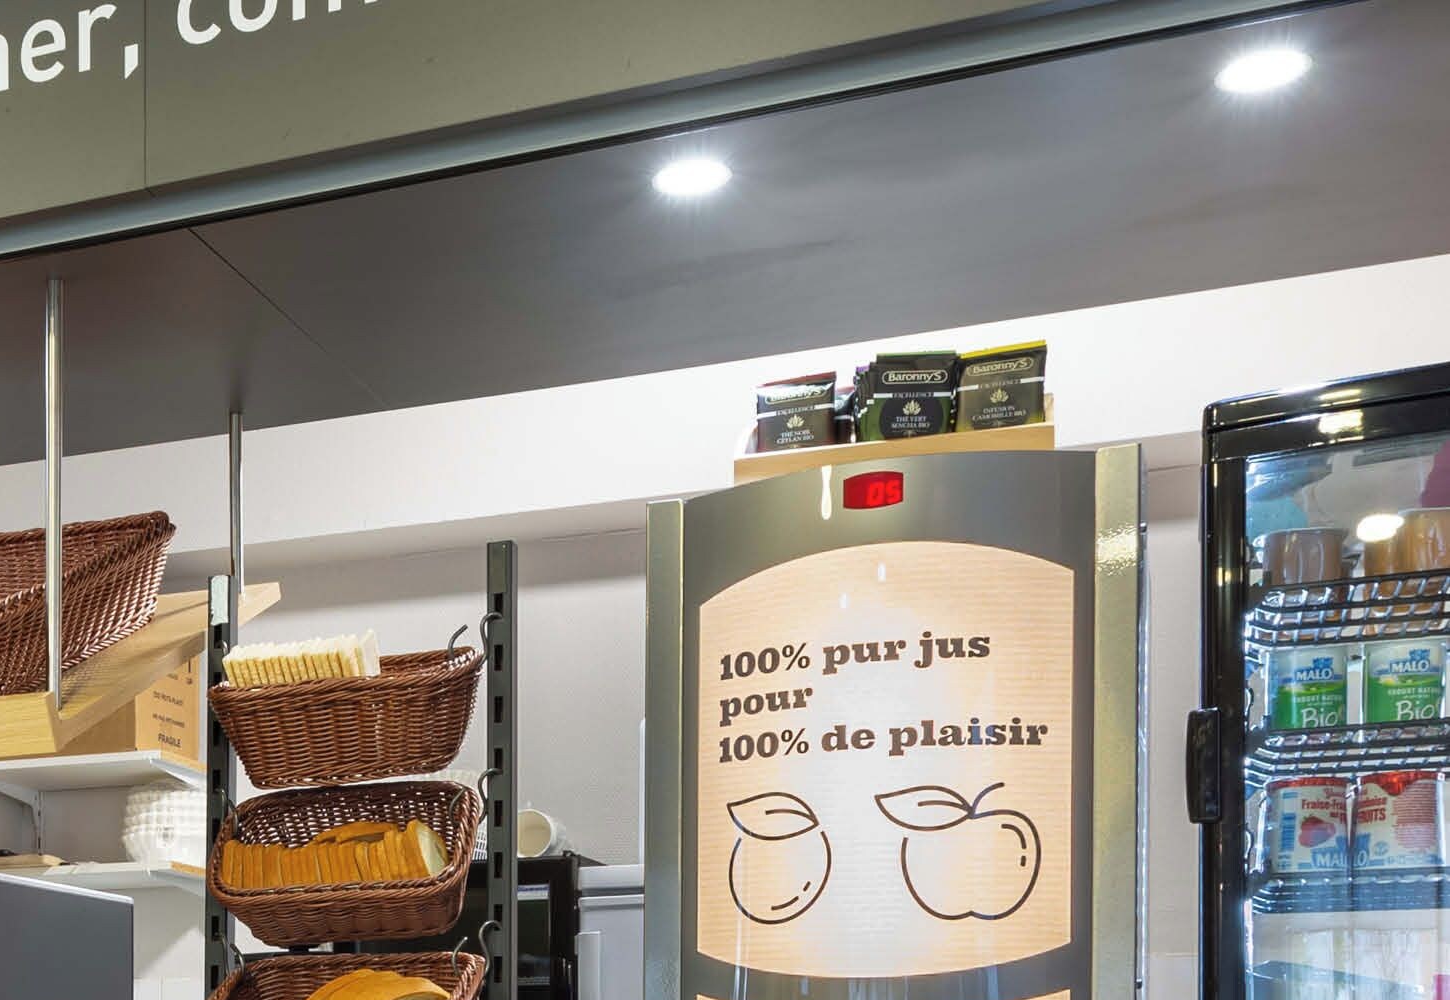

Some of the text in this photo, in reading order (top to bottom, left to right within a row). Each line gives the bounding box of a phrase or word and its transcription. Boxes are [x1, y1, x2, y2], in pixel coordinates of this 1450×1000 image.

[719, 630, 991, 681] 100% pur jus
[1296, 668, 1333, 682] MALO
[1391, 660, 1430, 674] MALO
[719, 687, 813, 727] pour
[1301, 706, 1339, 728] Bio
[1395, 700, 1436, 721] Bio
[719, 717, 1048, 764] 100% de plaisir
